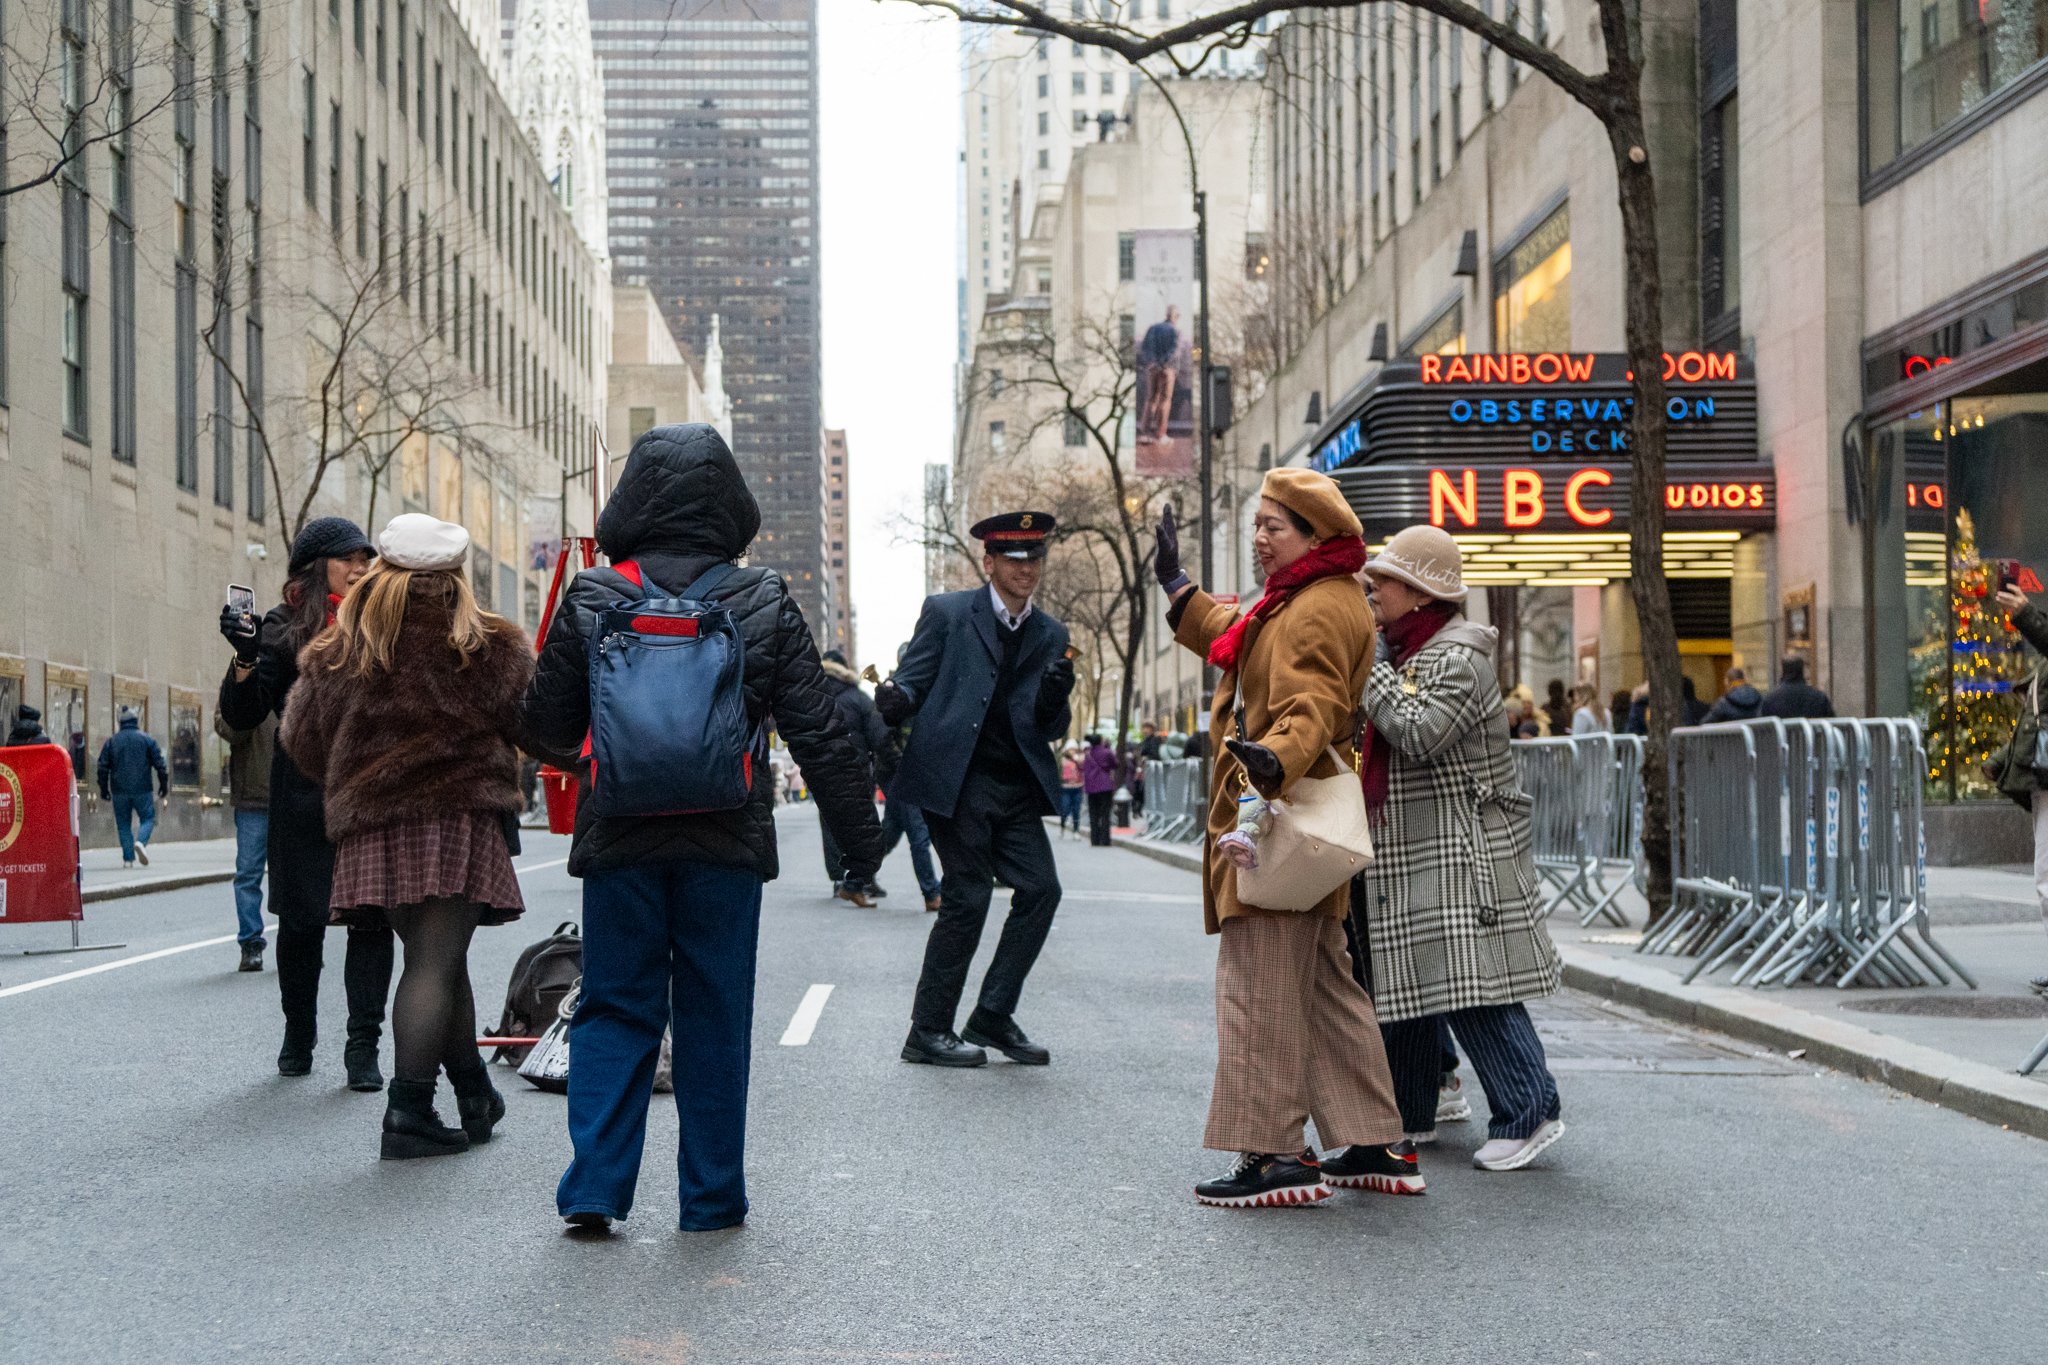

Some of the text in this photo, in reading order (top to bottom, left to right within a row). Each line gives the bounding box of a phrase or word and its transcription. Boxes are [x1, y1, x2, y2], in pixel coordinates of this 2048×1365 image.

[1421, 352, 1737, 384] RAINBOW OM
[1450, 396, 1715, 423] OBSERVAON
[1531, 429, 1628, 452] DECK
[1429, 467, 1764, 528] NBC UDIOS
[1828, 790, 1838, 852] NYPD
[1860, 784, 1869, 846] NYPD
[5, 864, 18, 874] GET
[18, 863, 47, 873] TICKETS!
[1808, 823, 1817, 885] NYPD
